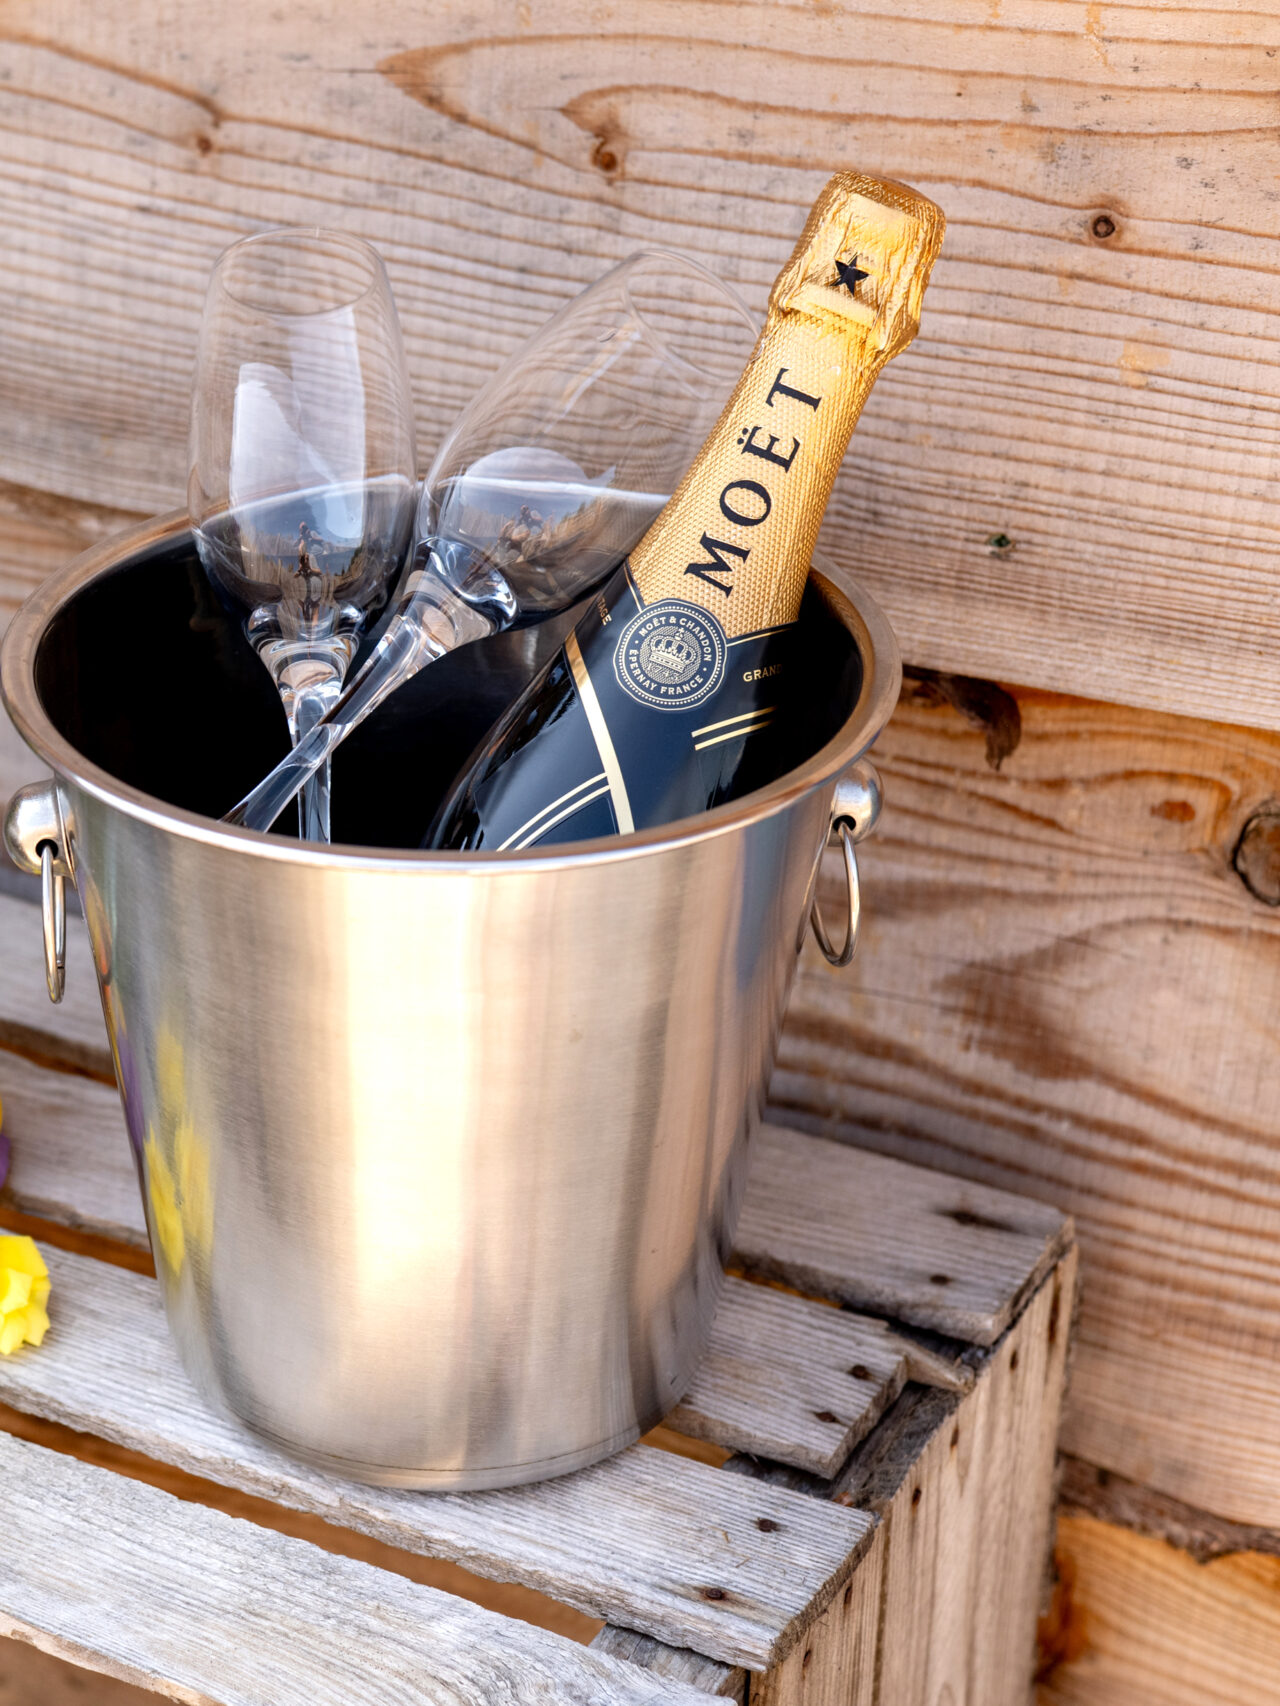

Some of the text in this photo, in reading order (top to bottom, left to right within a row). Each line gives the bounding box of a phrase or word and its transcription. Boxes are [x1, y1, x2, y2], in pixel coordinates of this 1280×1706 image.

[683, 367, 822, 598] MOËT
[638, 615, 712, 662] MOËT & CHANDON
[628, 648, 704, 695] ÉPERNAY FRANCE
